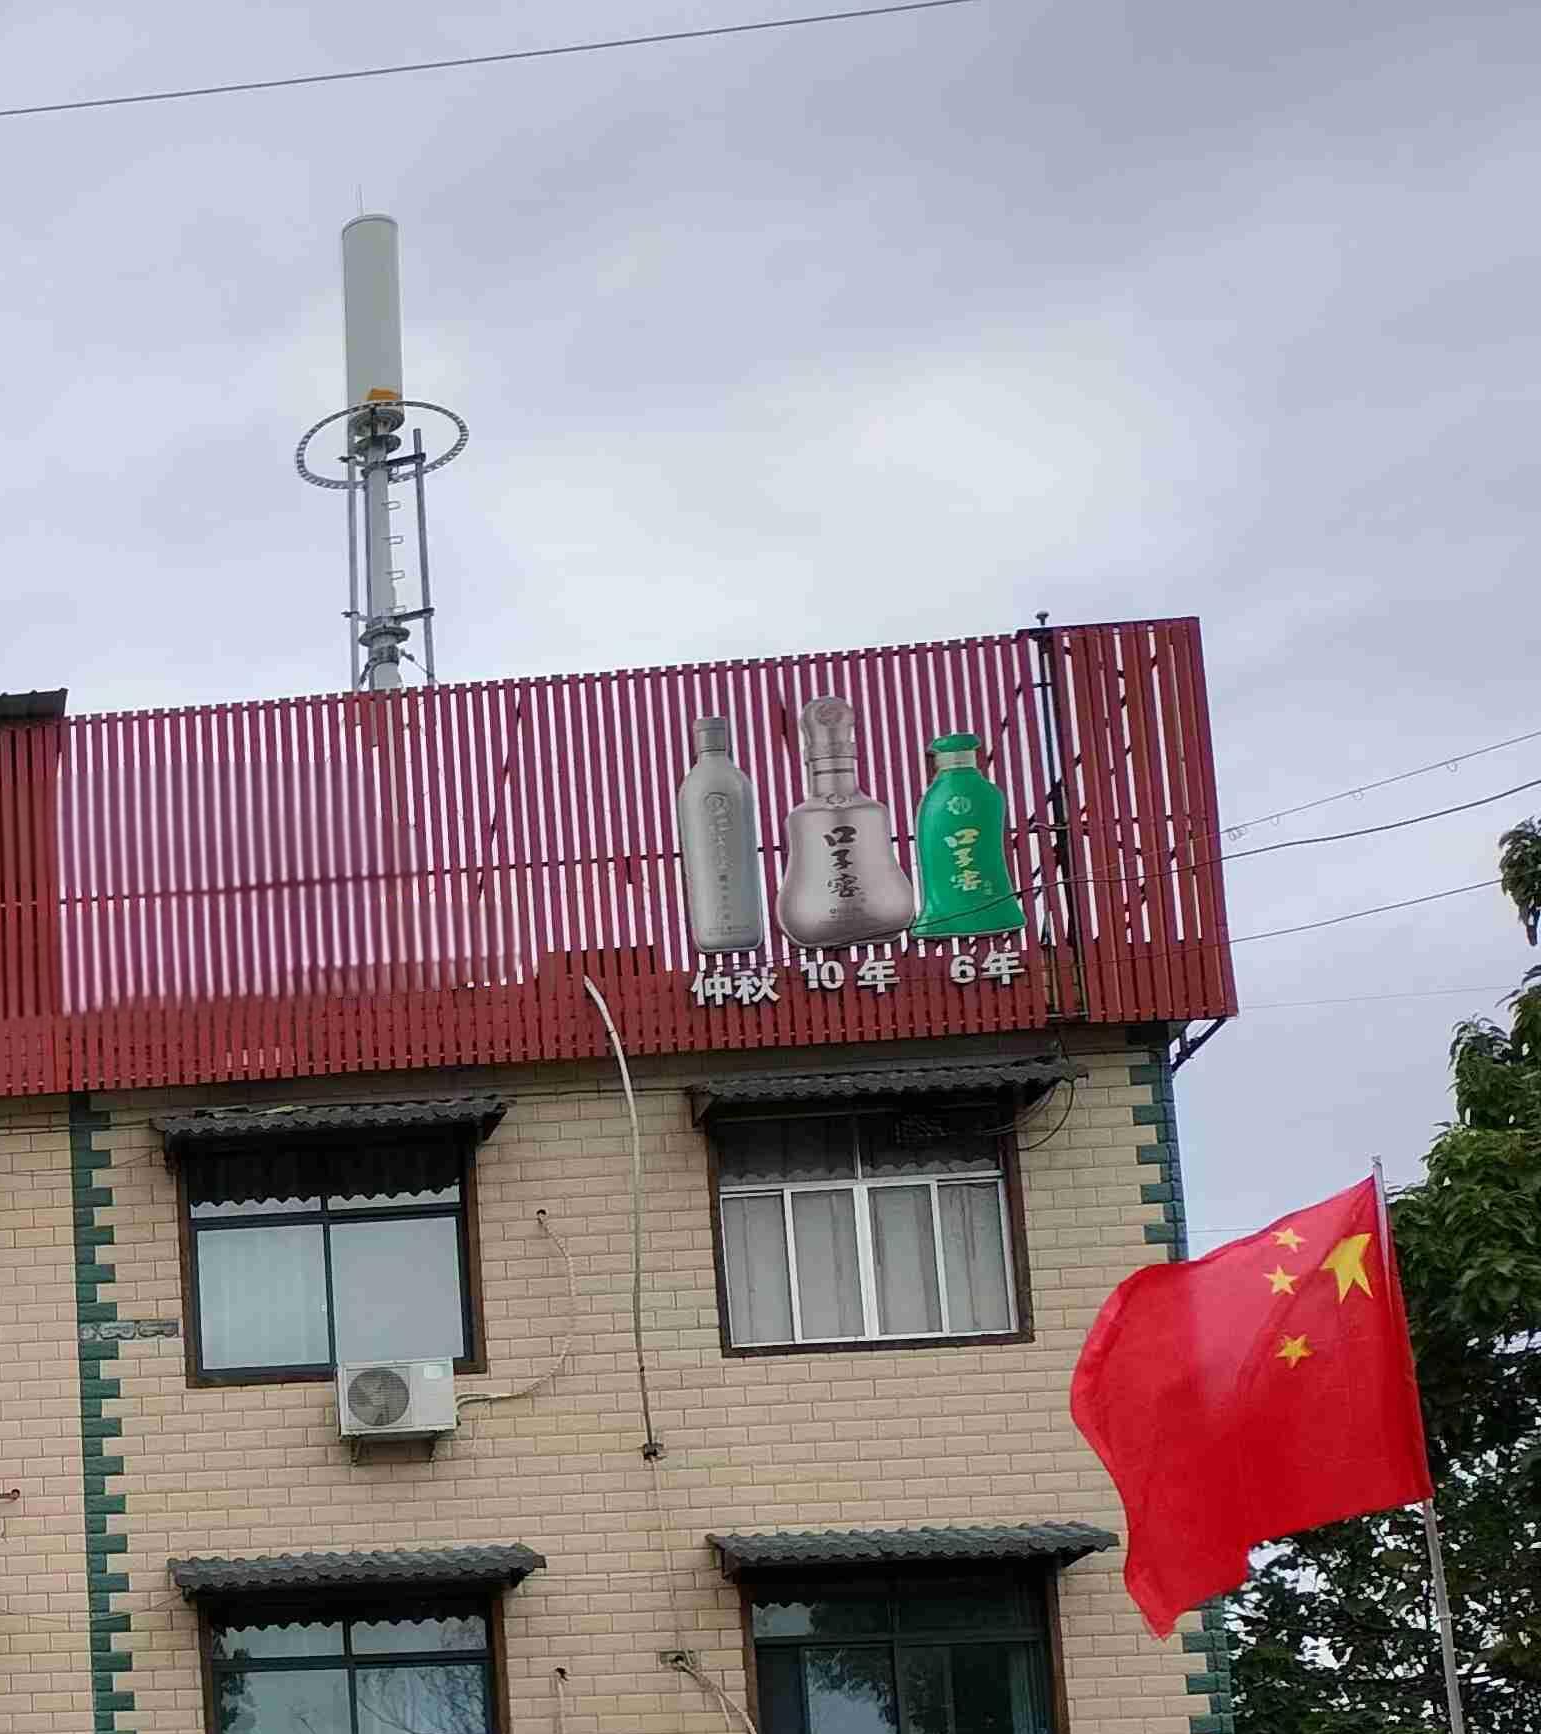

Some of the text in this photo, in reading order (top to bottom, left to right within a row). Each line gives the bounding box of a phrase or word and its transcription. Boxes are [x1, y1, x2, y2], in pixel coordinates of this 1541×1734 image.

[800, 959, 900, 993] 10年
[950, 949, 1025, 985] 6年
[691, 969, 780, 1006] 仲秋
